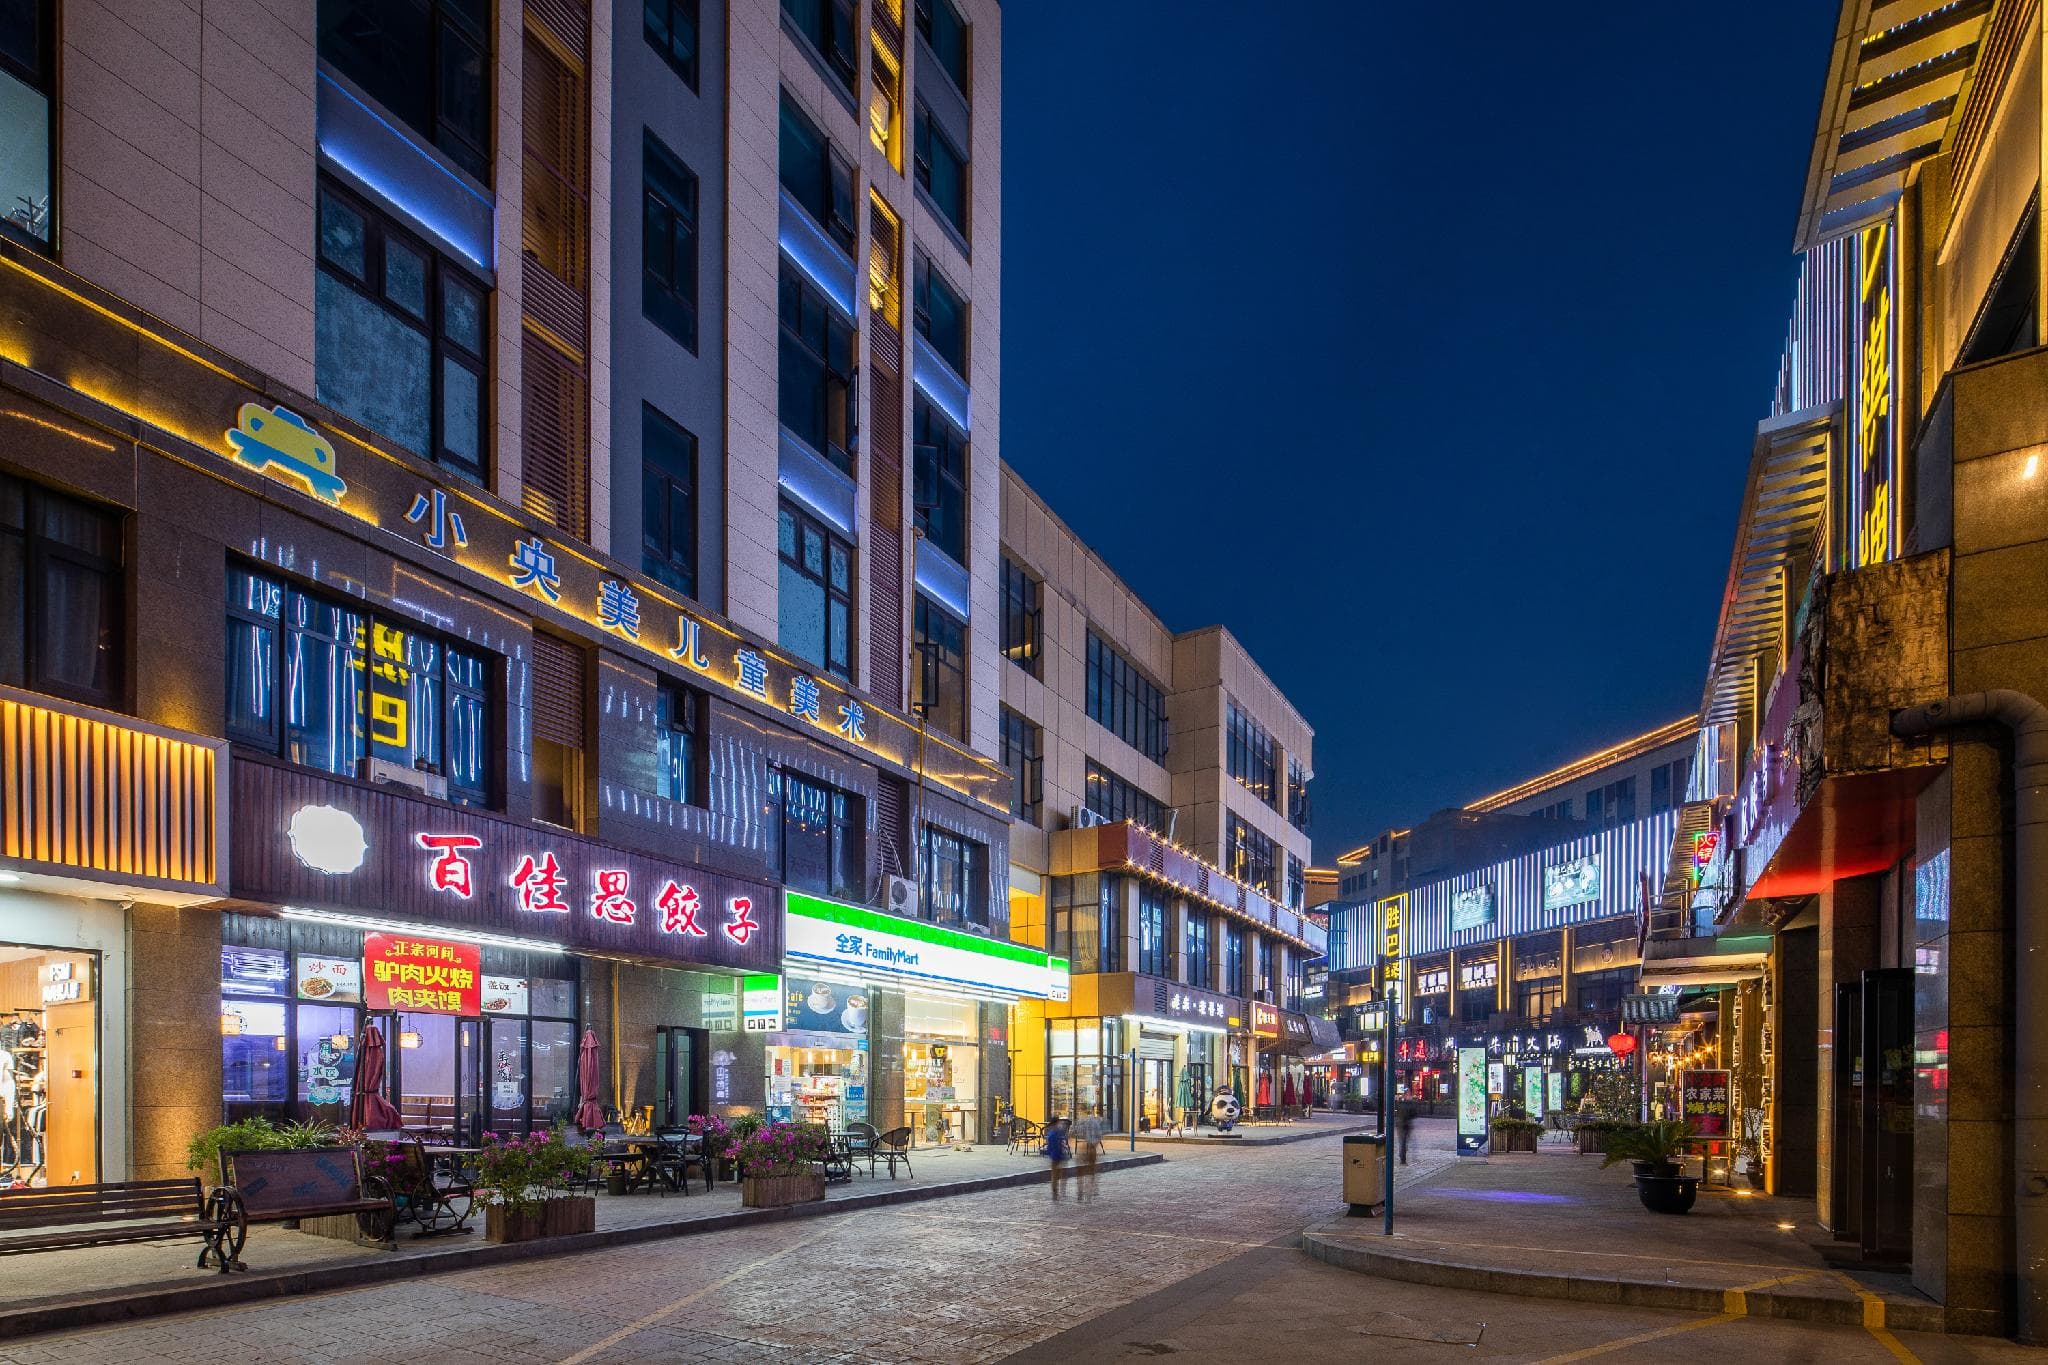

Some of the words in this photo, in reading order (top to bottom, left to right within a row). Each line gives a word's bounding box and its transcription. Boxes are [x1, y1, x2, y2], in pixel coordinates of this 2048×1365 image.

[404, 488, 867, 742] 小央美儿童美术
[393, 940, 458, 962] 正宗河间
[835, 933, 863, 957] 全家
[865, 942, 920, 966] FamilyMart
[373, 959, 474, 990] 驴肉火烧
[388, 988, 462, 1012] 肉夹馍
[1686, 1087, 1726, 1101] 农家菜
